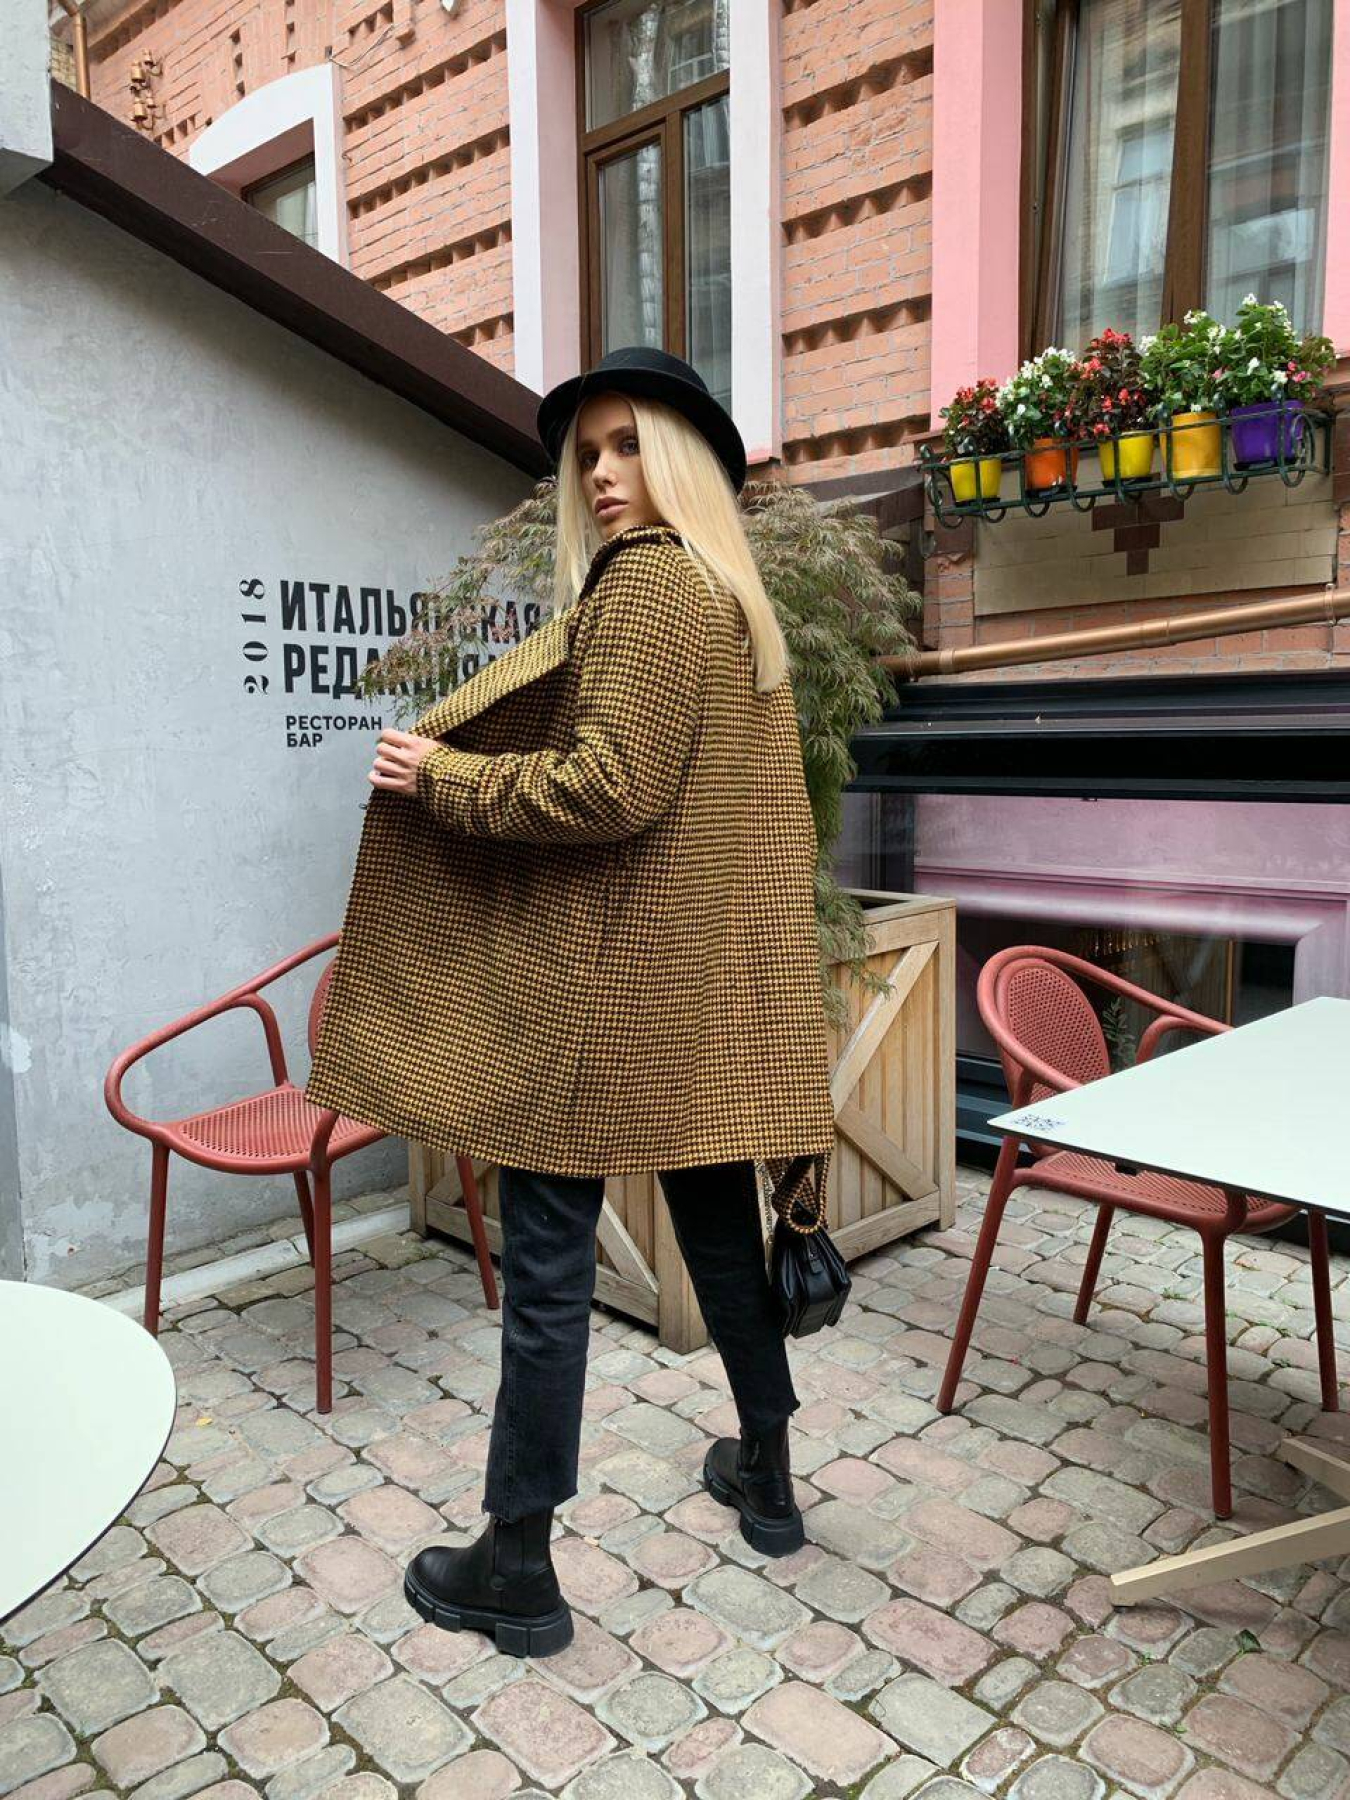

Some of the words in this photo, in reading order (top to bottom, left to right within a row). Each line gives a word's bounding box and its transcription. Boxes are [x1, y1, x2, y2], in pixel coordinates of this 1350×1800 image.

[280, 580, 541, 644] ИТАЛЬЯКАЯ
[239, 578, 269, 695] 2018
[286, 715, 382, 731] РЕСТОРАН
[287, 733, 323, 748] БАР
